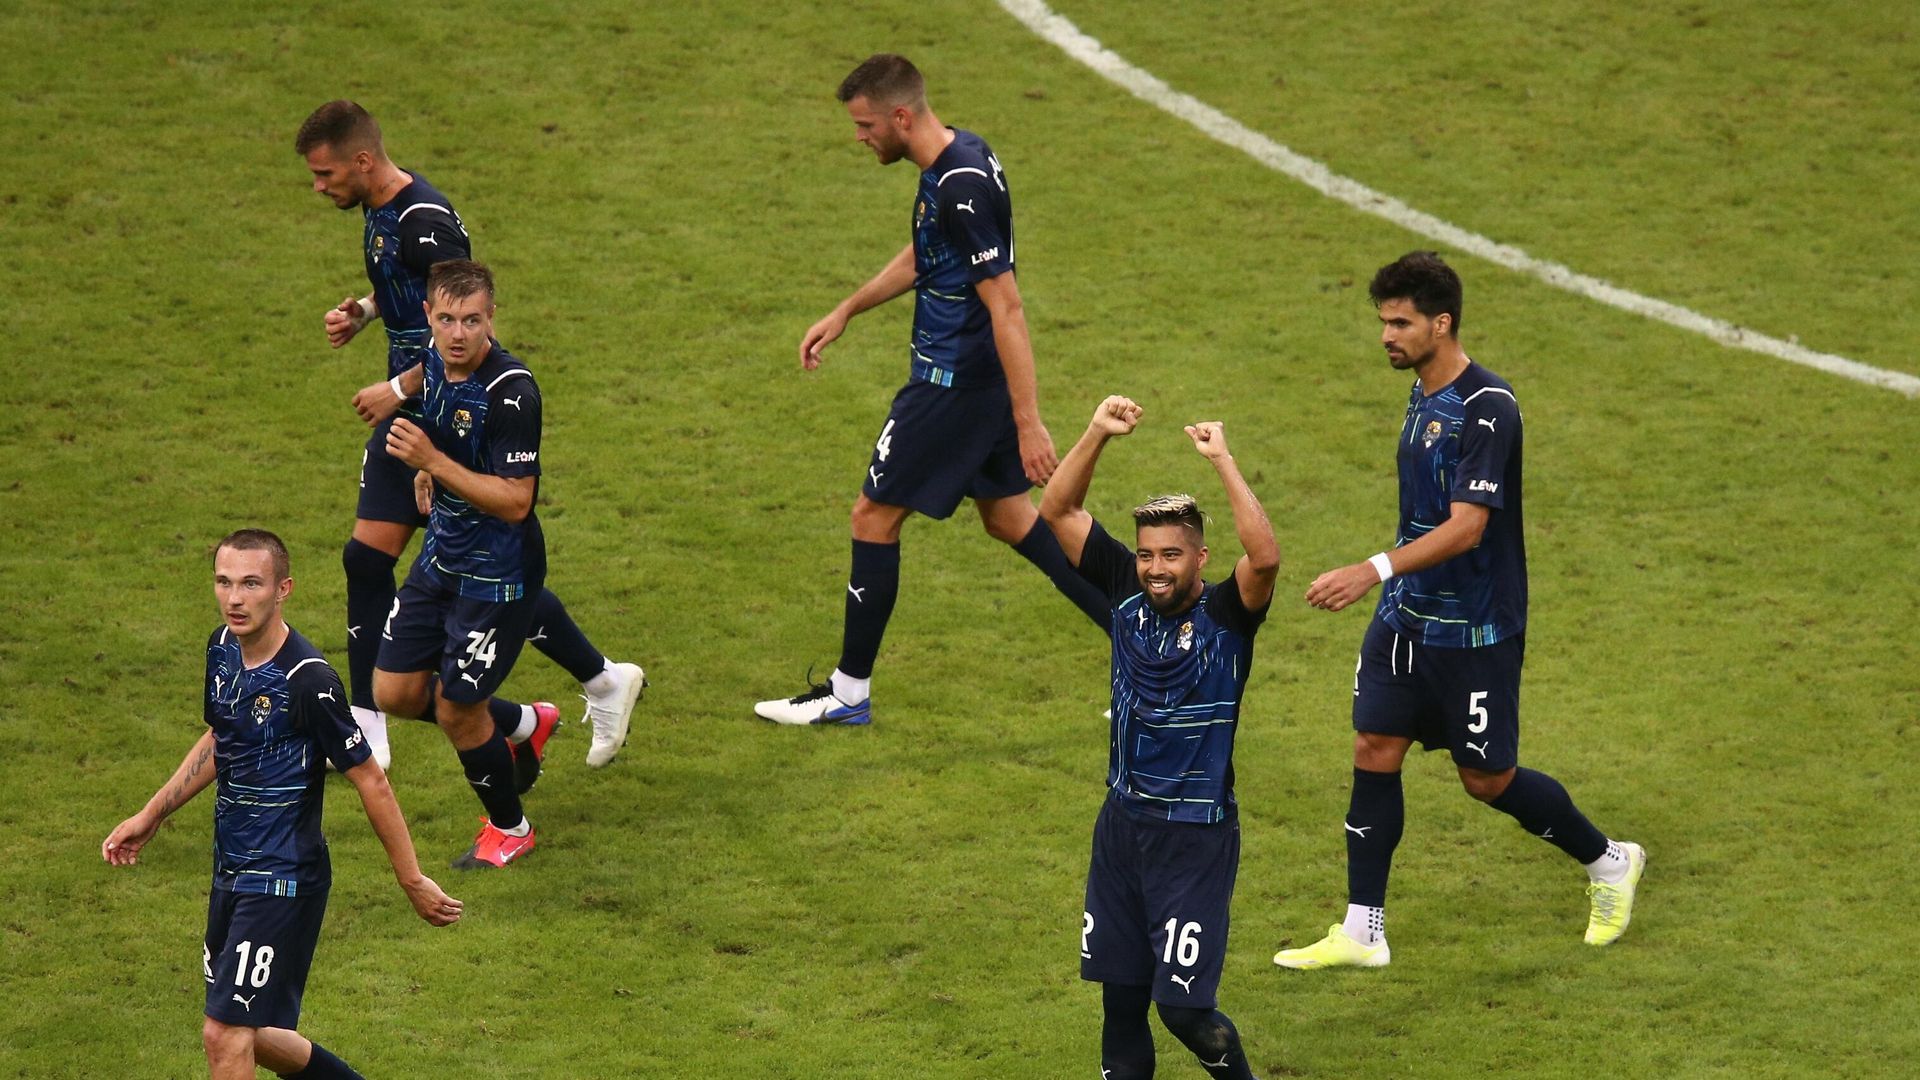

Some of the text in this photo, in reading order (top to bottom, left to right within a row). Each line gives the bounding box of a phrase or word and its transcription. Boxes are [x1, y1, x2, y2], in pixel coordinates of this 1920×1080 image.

[506, 451, 537, 463] LEON
[876, 418, 895, 462] 4
[457, 627, 497, 669] 34
[1467, 690, 1488, 733] 5
[1163, 917, 1202, 967] 16
[234, 940, 274, 988] 18
